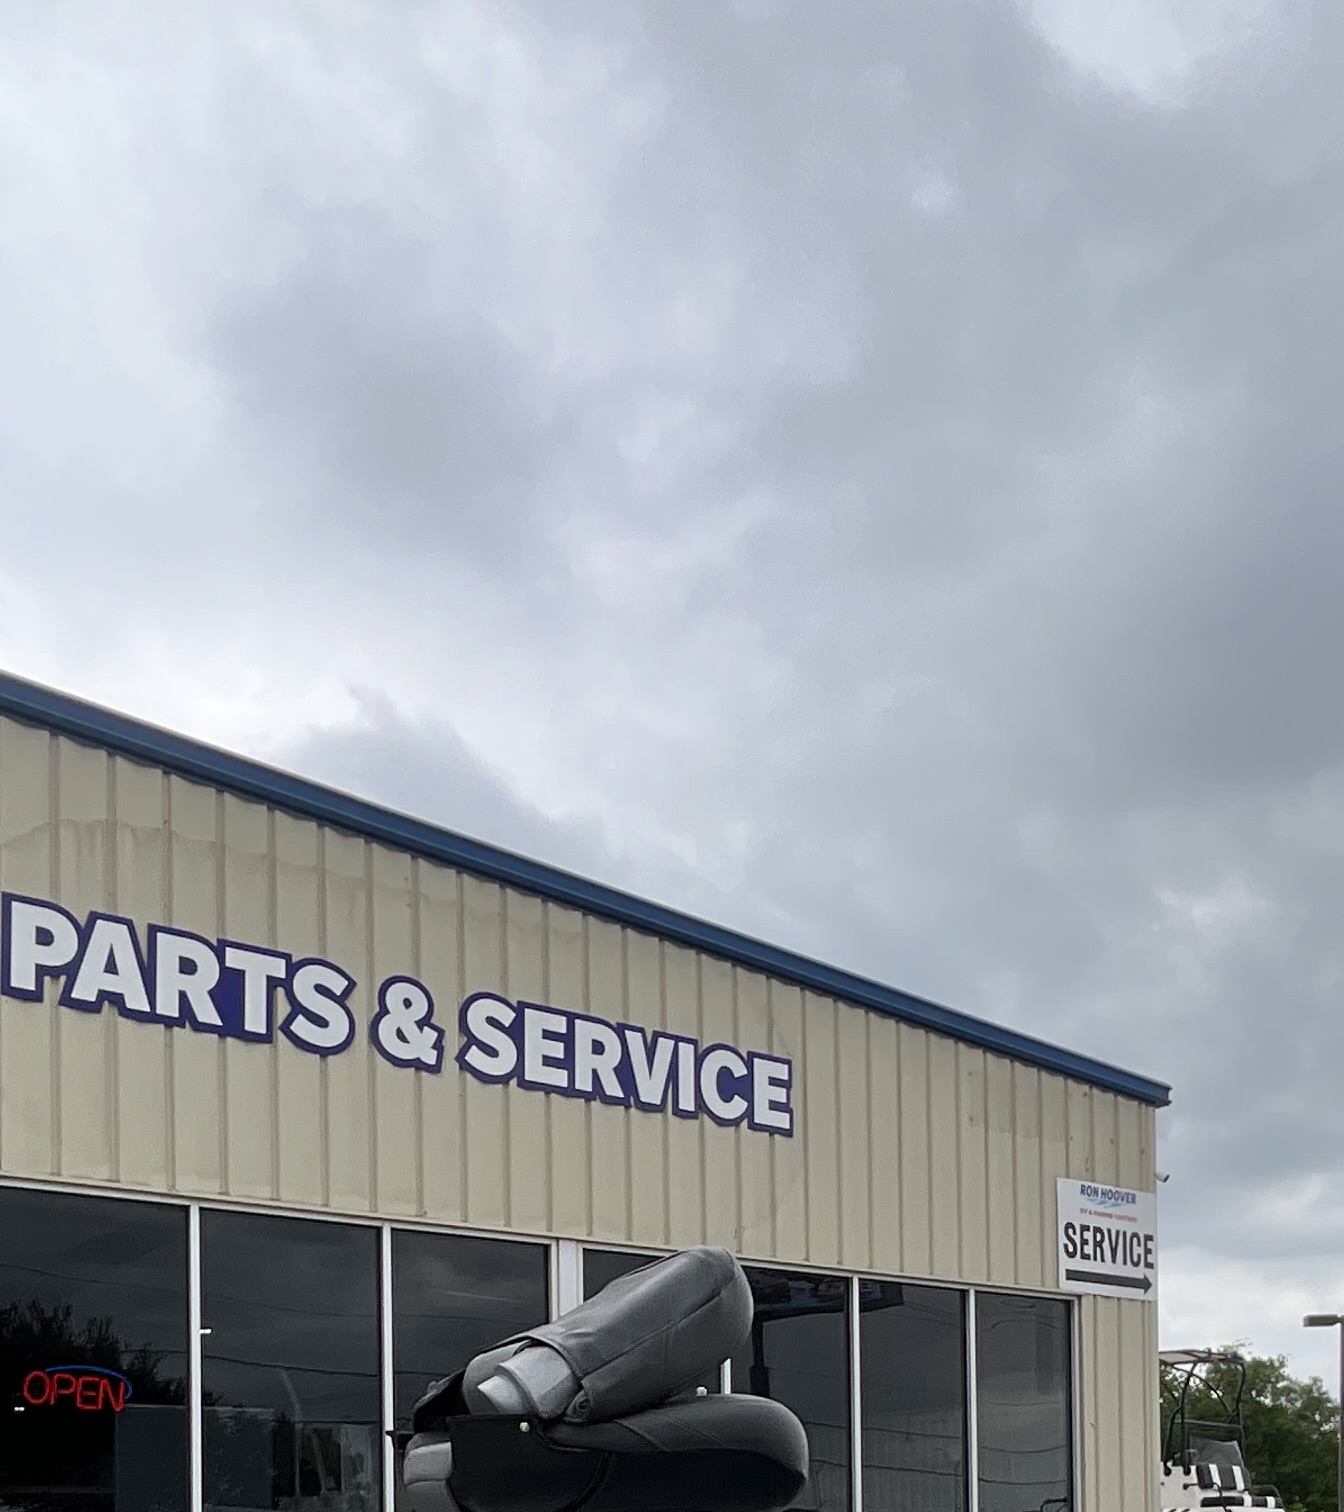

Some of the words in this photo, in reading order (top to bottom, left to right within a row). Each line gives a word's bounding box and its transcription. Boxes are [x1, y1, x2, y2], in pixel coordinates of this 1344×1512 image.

[3, 893, 354, 1054] PARTS
[373, 976, 443, 1073] &
[458, 990, 793, 1135] SERVICE
[1080, 1184, 1099, 1198] RON
[1100, 1188, 1137, 1204] HOOVER
[1063, 1222, 1154, 1269] SERVICE
[23, 1371, 125, 1412] OPEN
